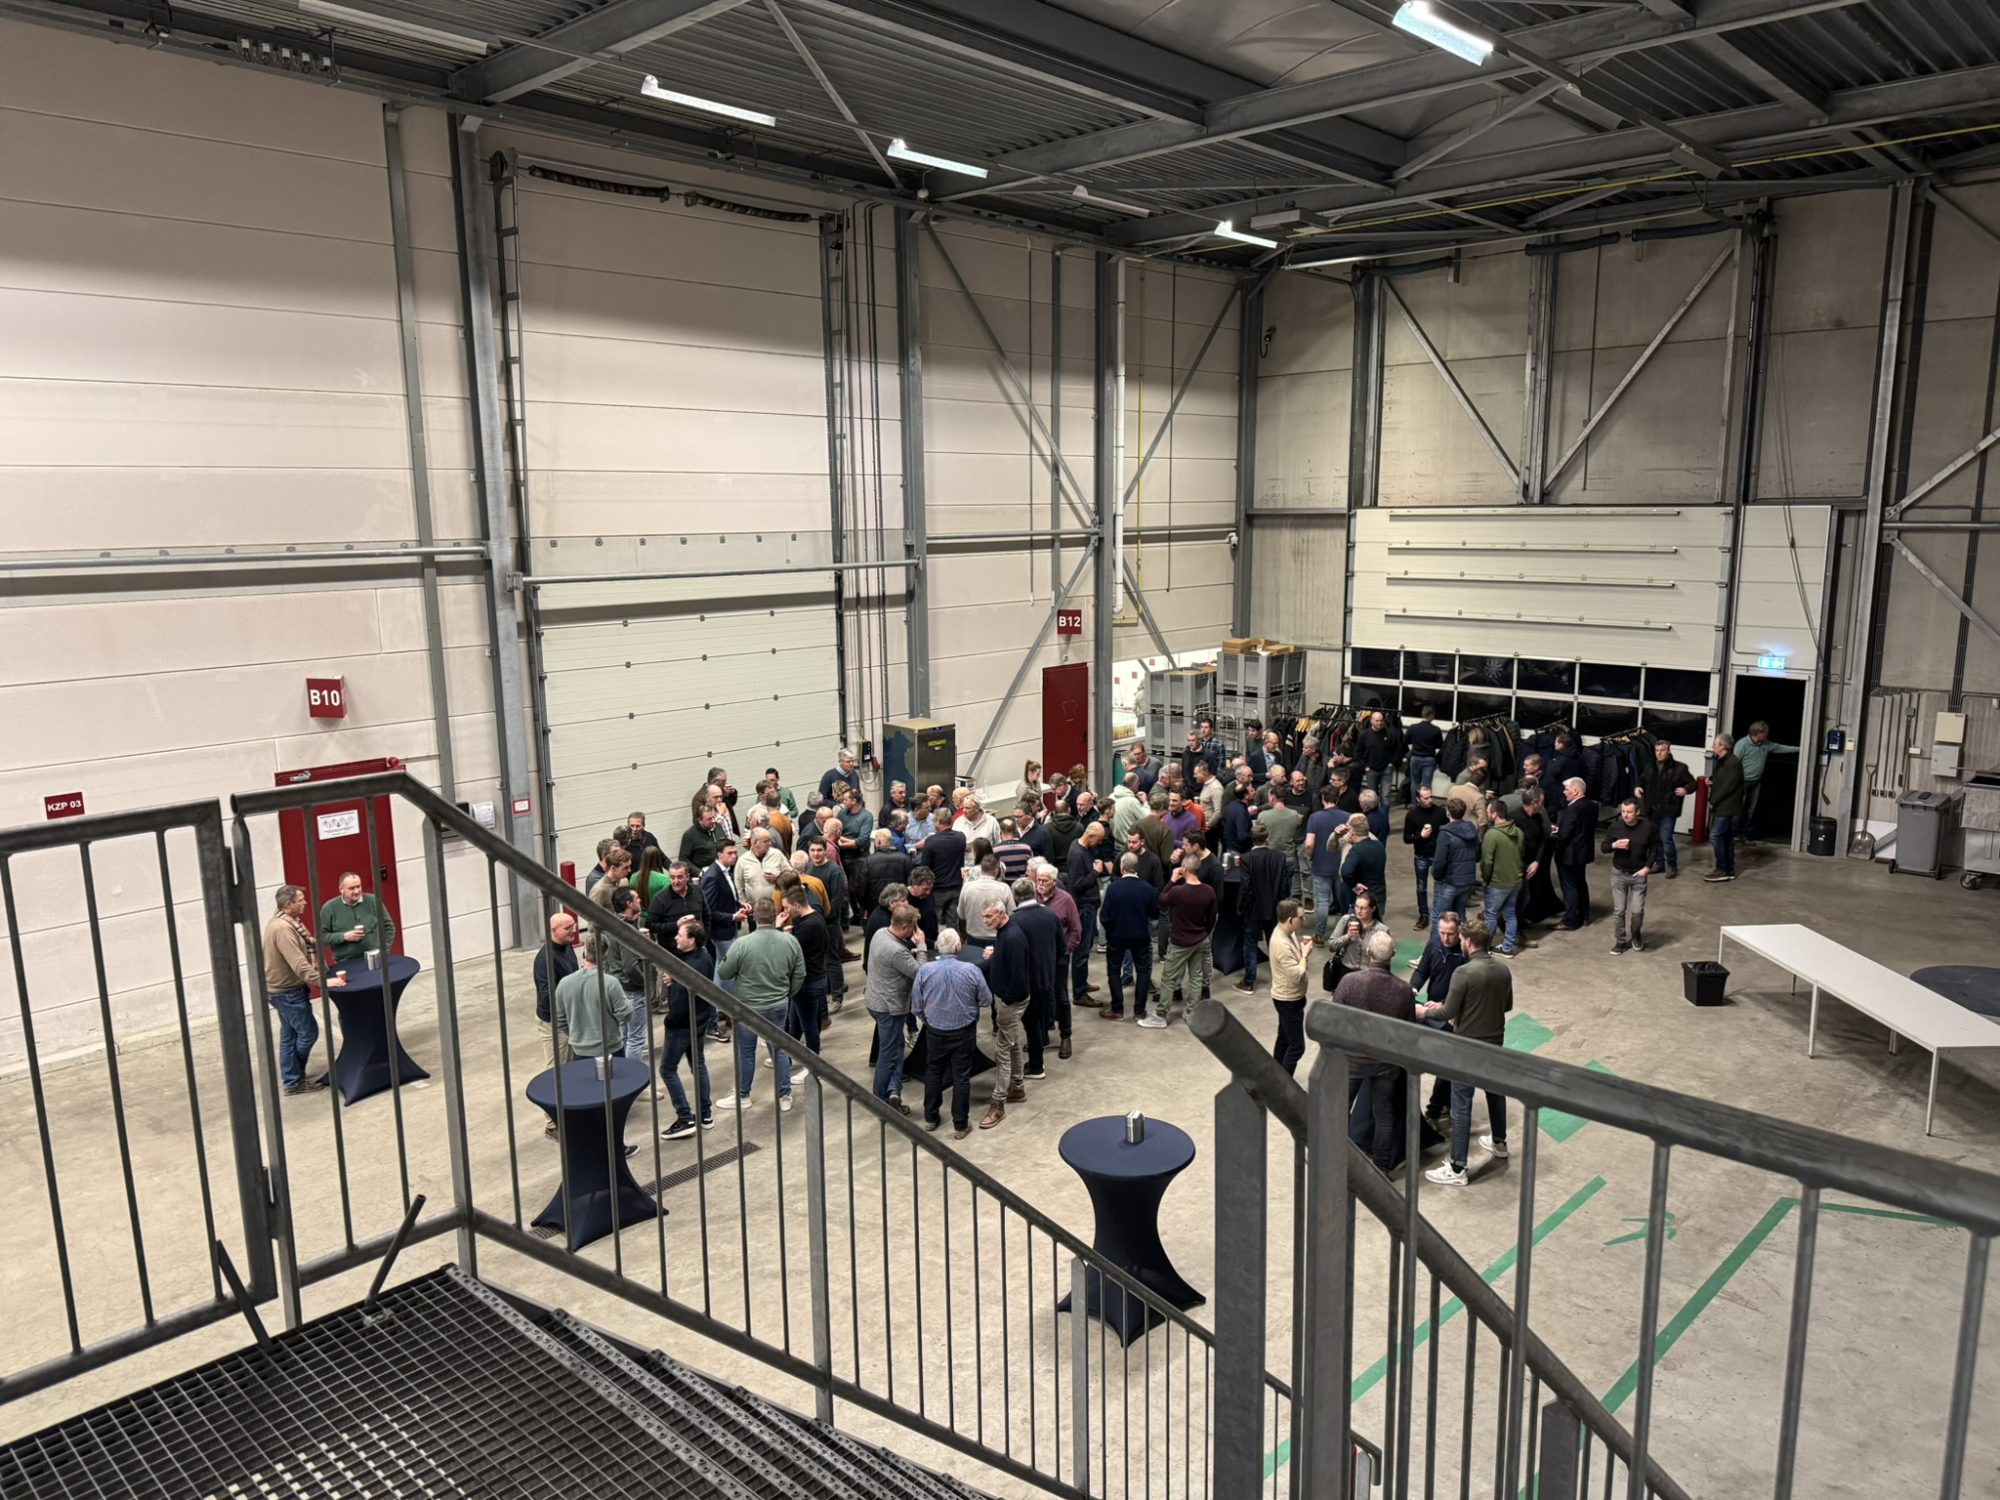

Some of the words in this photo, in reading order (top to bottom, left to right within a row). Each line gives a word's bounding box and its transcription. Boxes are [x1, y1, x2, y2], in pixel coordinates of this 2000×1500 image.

[1059, 616, 1081, 627] B12
[310, 689, 341, 706] B10
[48, 802, 68, 812] KZP
[70, 800, 82, 808] 03
